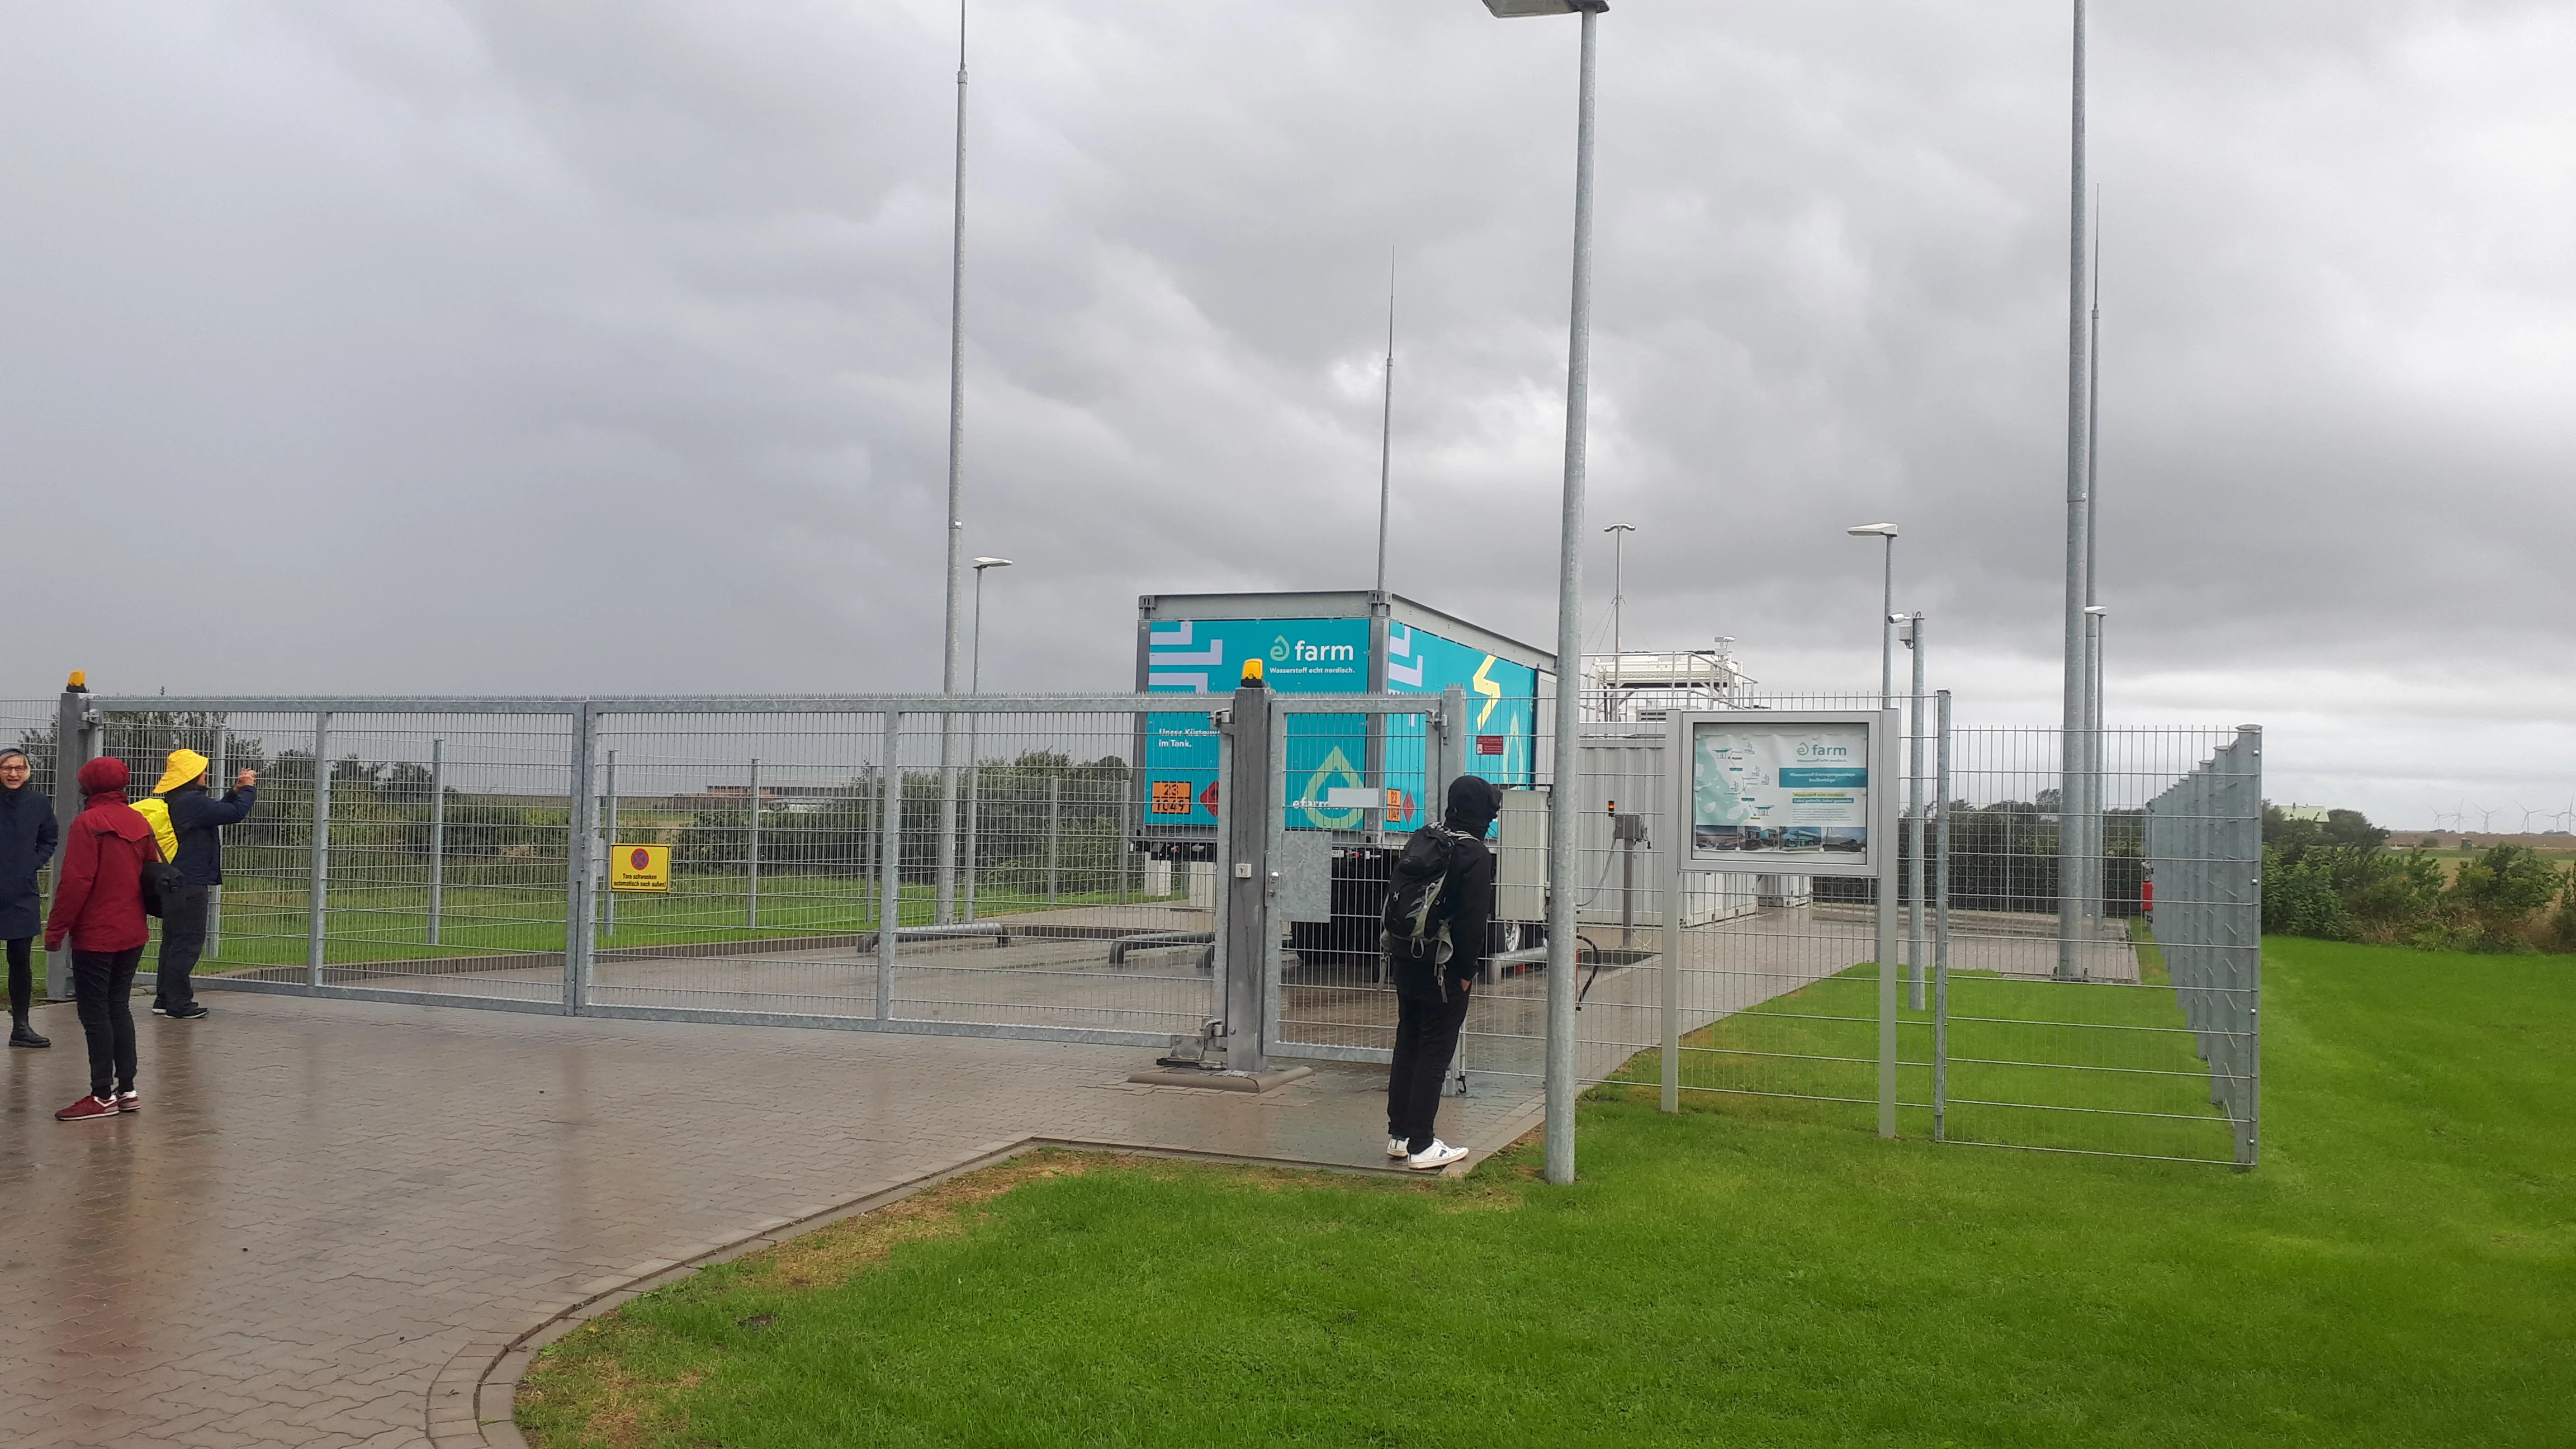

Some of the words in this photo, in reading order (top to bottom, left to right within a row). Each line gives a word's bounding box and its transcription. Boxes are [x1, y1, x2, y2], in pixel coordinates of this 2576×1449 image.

[1294, 640, 1354, 661] farm
[1812, 744, 1847, 756] farm
[1163, 784, 1178, 796] 23
[1391, 790, 1397, 804] 23
[1156, 799, 1185, 812] 1049
